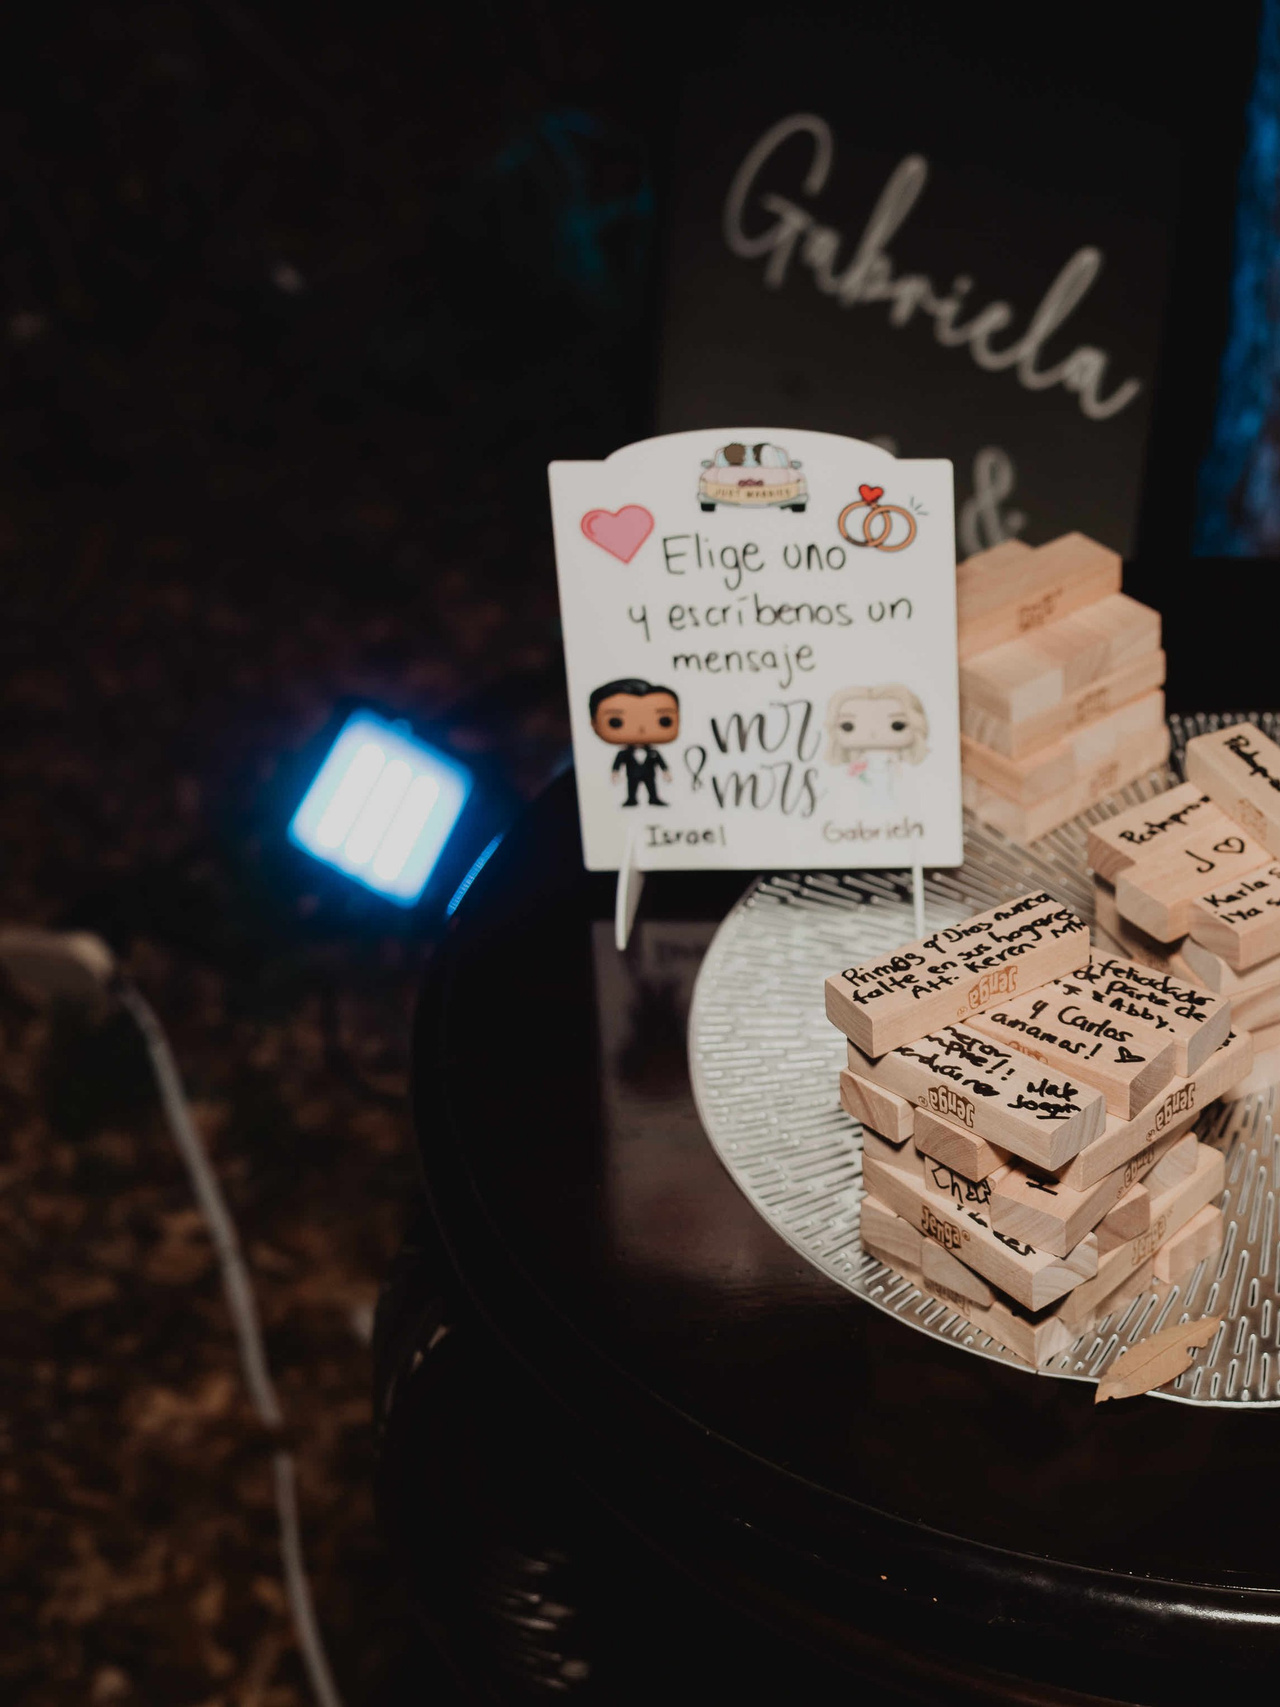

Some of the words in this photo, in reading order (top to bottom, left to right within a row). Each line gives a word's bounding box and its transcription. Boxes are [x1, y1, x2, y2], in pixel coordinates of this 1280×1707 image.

[721, 113, 1142, 421] Gabriela
[662, 532, 766, 591] Elige
[782, 543, 847, 571] uno
[628, 604, 652, 642] y
[669, 594, 853, 632] escríbenos
[868, 596, 913, 622] un
[673, 643, 816, 689] mensaje
[645, 825, 727, 848] Israel
[1203, 879, 1271, 909] Karla
[942, 923, 994, 944] Dios
[994, 892, 1059, 922] nunca
[852, 972, 920, 1006] falte
[927, 960, 958, 976] en
[957, 943, 993, 961] sus
[967, 965, 1019, 1011] Jenga
[1057, 1005, 1134, 1043] Carlos
[1174, 1004, 1208, 1023] de
[928, 1085, 976, 1129] Jenga
[1155, 1082, 1196, 1132] Jenga
[921, 1205, 962, 1250] Jenga
